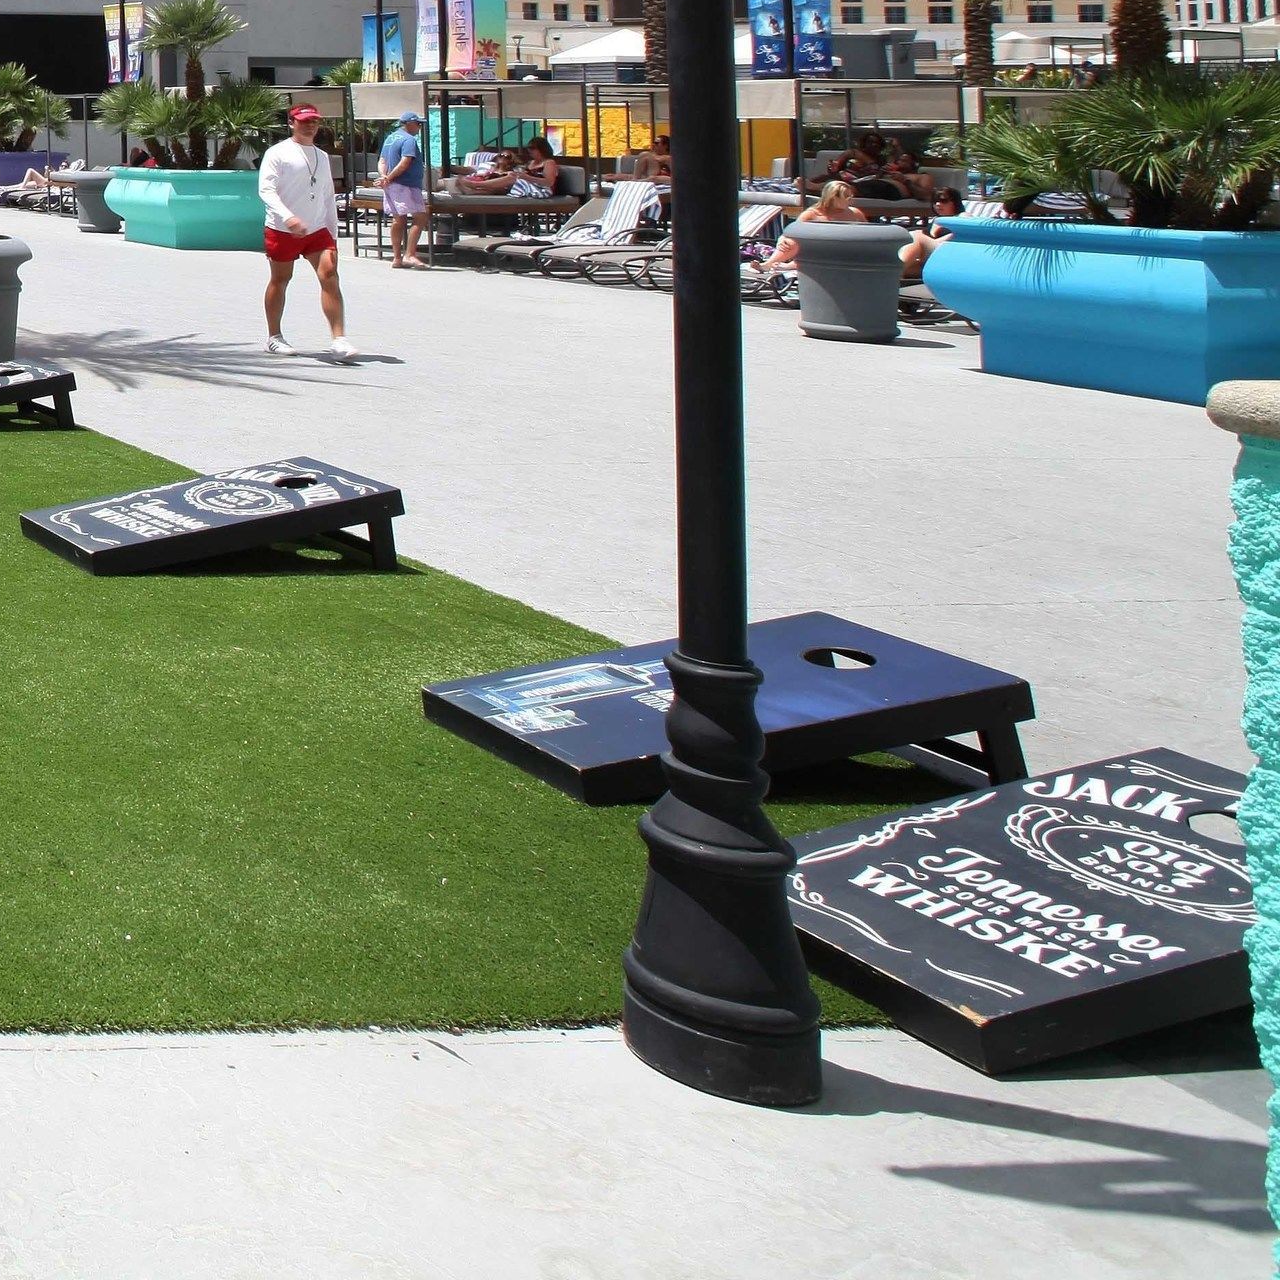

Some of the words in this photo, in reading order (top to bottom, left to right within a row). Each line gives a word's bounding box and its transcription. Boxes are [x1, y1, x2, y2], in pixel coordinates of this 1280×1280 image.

[1022, 773, 1203, 823] JACK
[1077, 856, 1176, 894] BRAND
[1122, 840, 1215, 877] Old
[847, 865, 1117, 980] WHISKE
[938, 884, 1011, 916] SOUR
[1014, 916, 1097, 951] MASH
